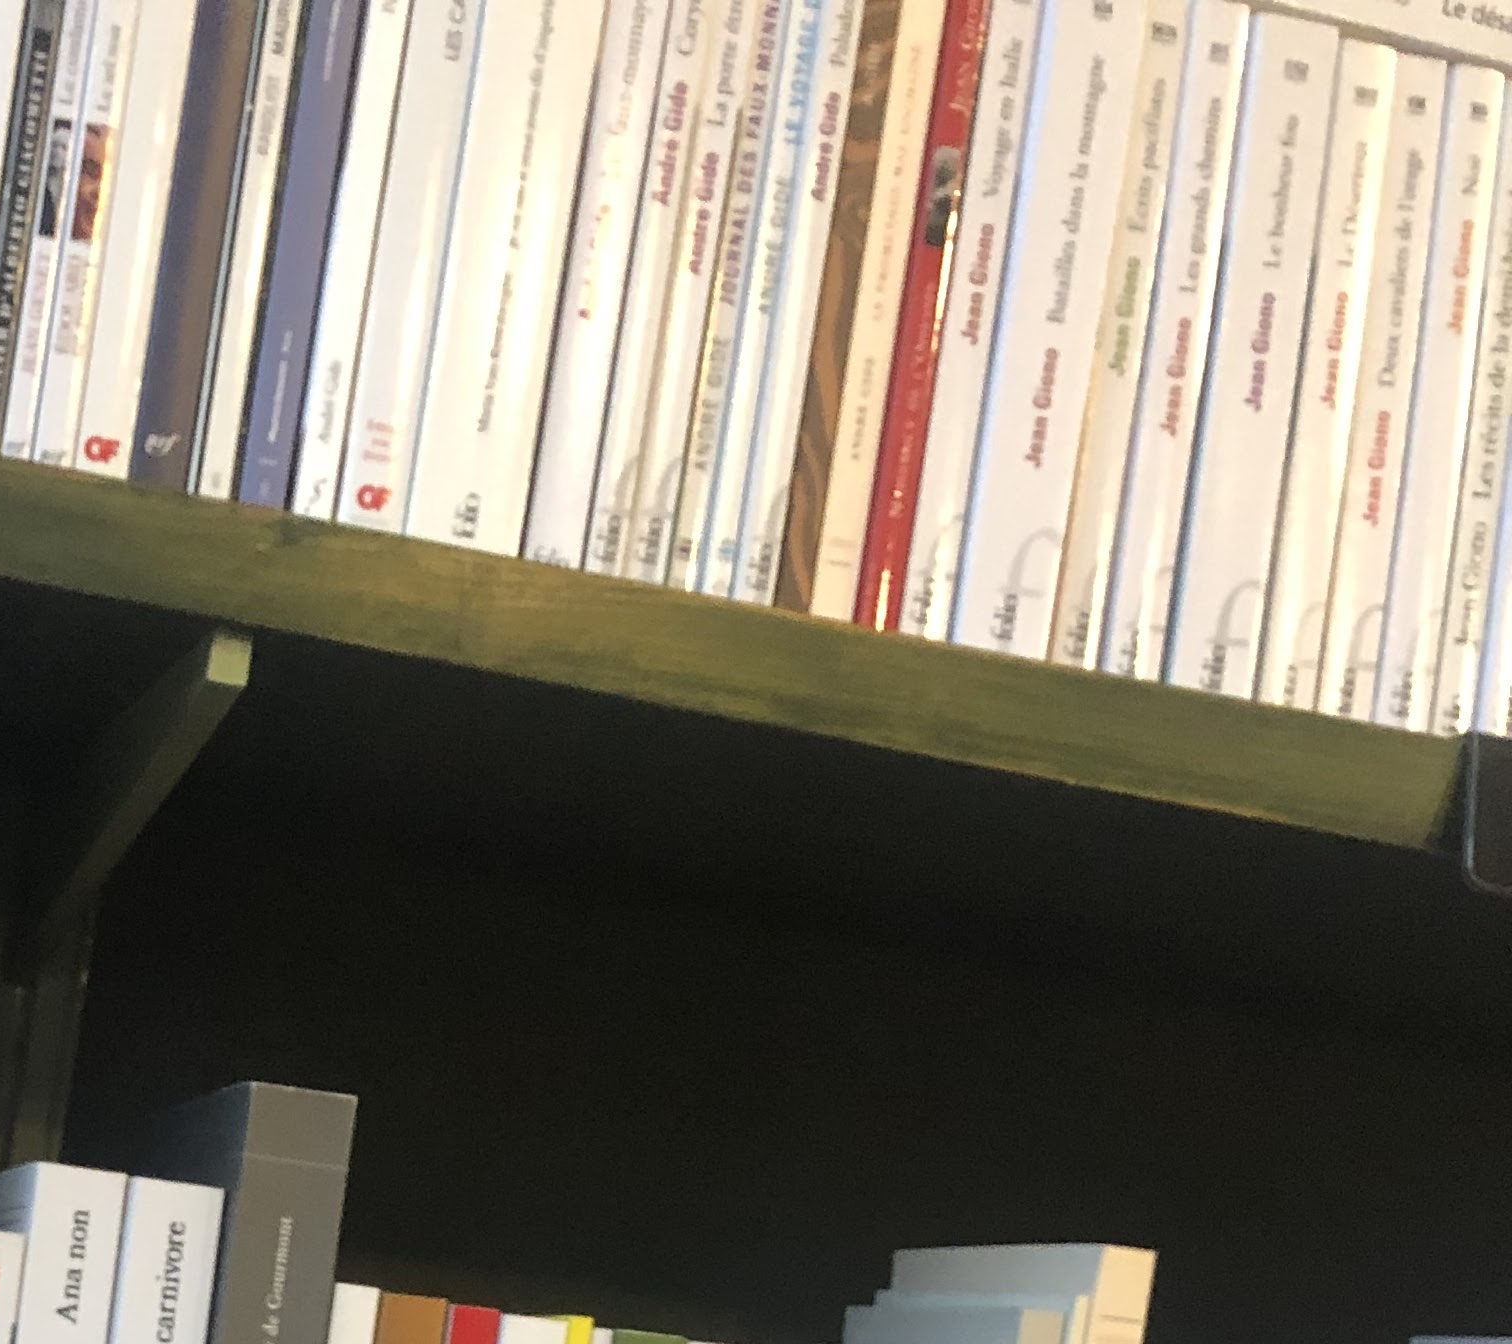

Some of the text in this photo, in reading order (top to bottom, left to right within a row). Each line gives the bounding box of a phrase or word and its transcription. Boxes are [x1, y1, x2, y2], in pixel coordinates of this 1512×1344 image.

[664, 81, 688, 131] Gide
[818, 90, 841, 137] Gide
[697, 152, 719, 202] Gide
[1061, 186, 1083, 234] dans
[970, 223, 994, 287] Giono
[1243, 154, 1294, 414] Jean Giono Le bonheur
[1447, 218, 1474, 336] Jean Giono
[961, 292, 984, 345] Jean
[1108, 256, 1140, 378] Jean Giono
[1166, 316, 1192, 379] Giono
[1032, 347, 1061, 410] Giono
[1319, 290, 1349, 411] Jean Giono
[1024, 416, 1048, 469] Jean
[1161, 385, 1183, 439] Jean
[1367, 409, 1392, 471] Giono
[1362, 475, 1384, 529] Jean
[56, 1209, 90, 1325] Ana non
[156, 1220, 187, 1343] carnivore
